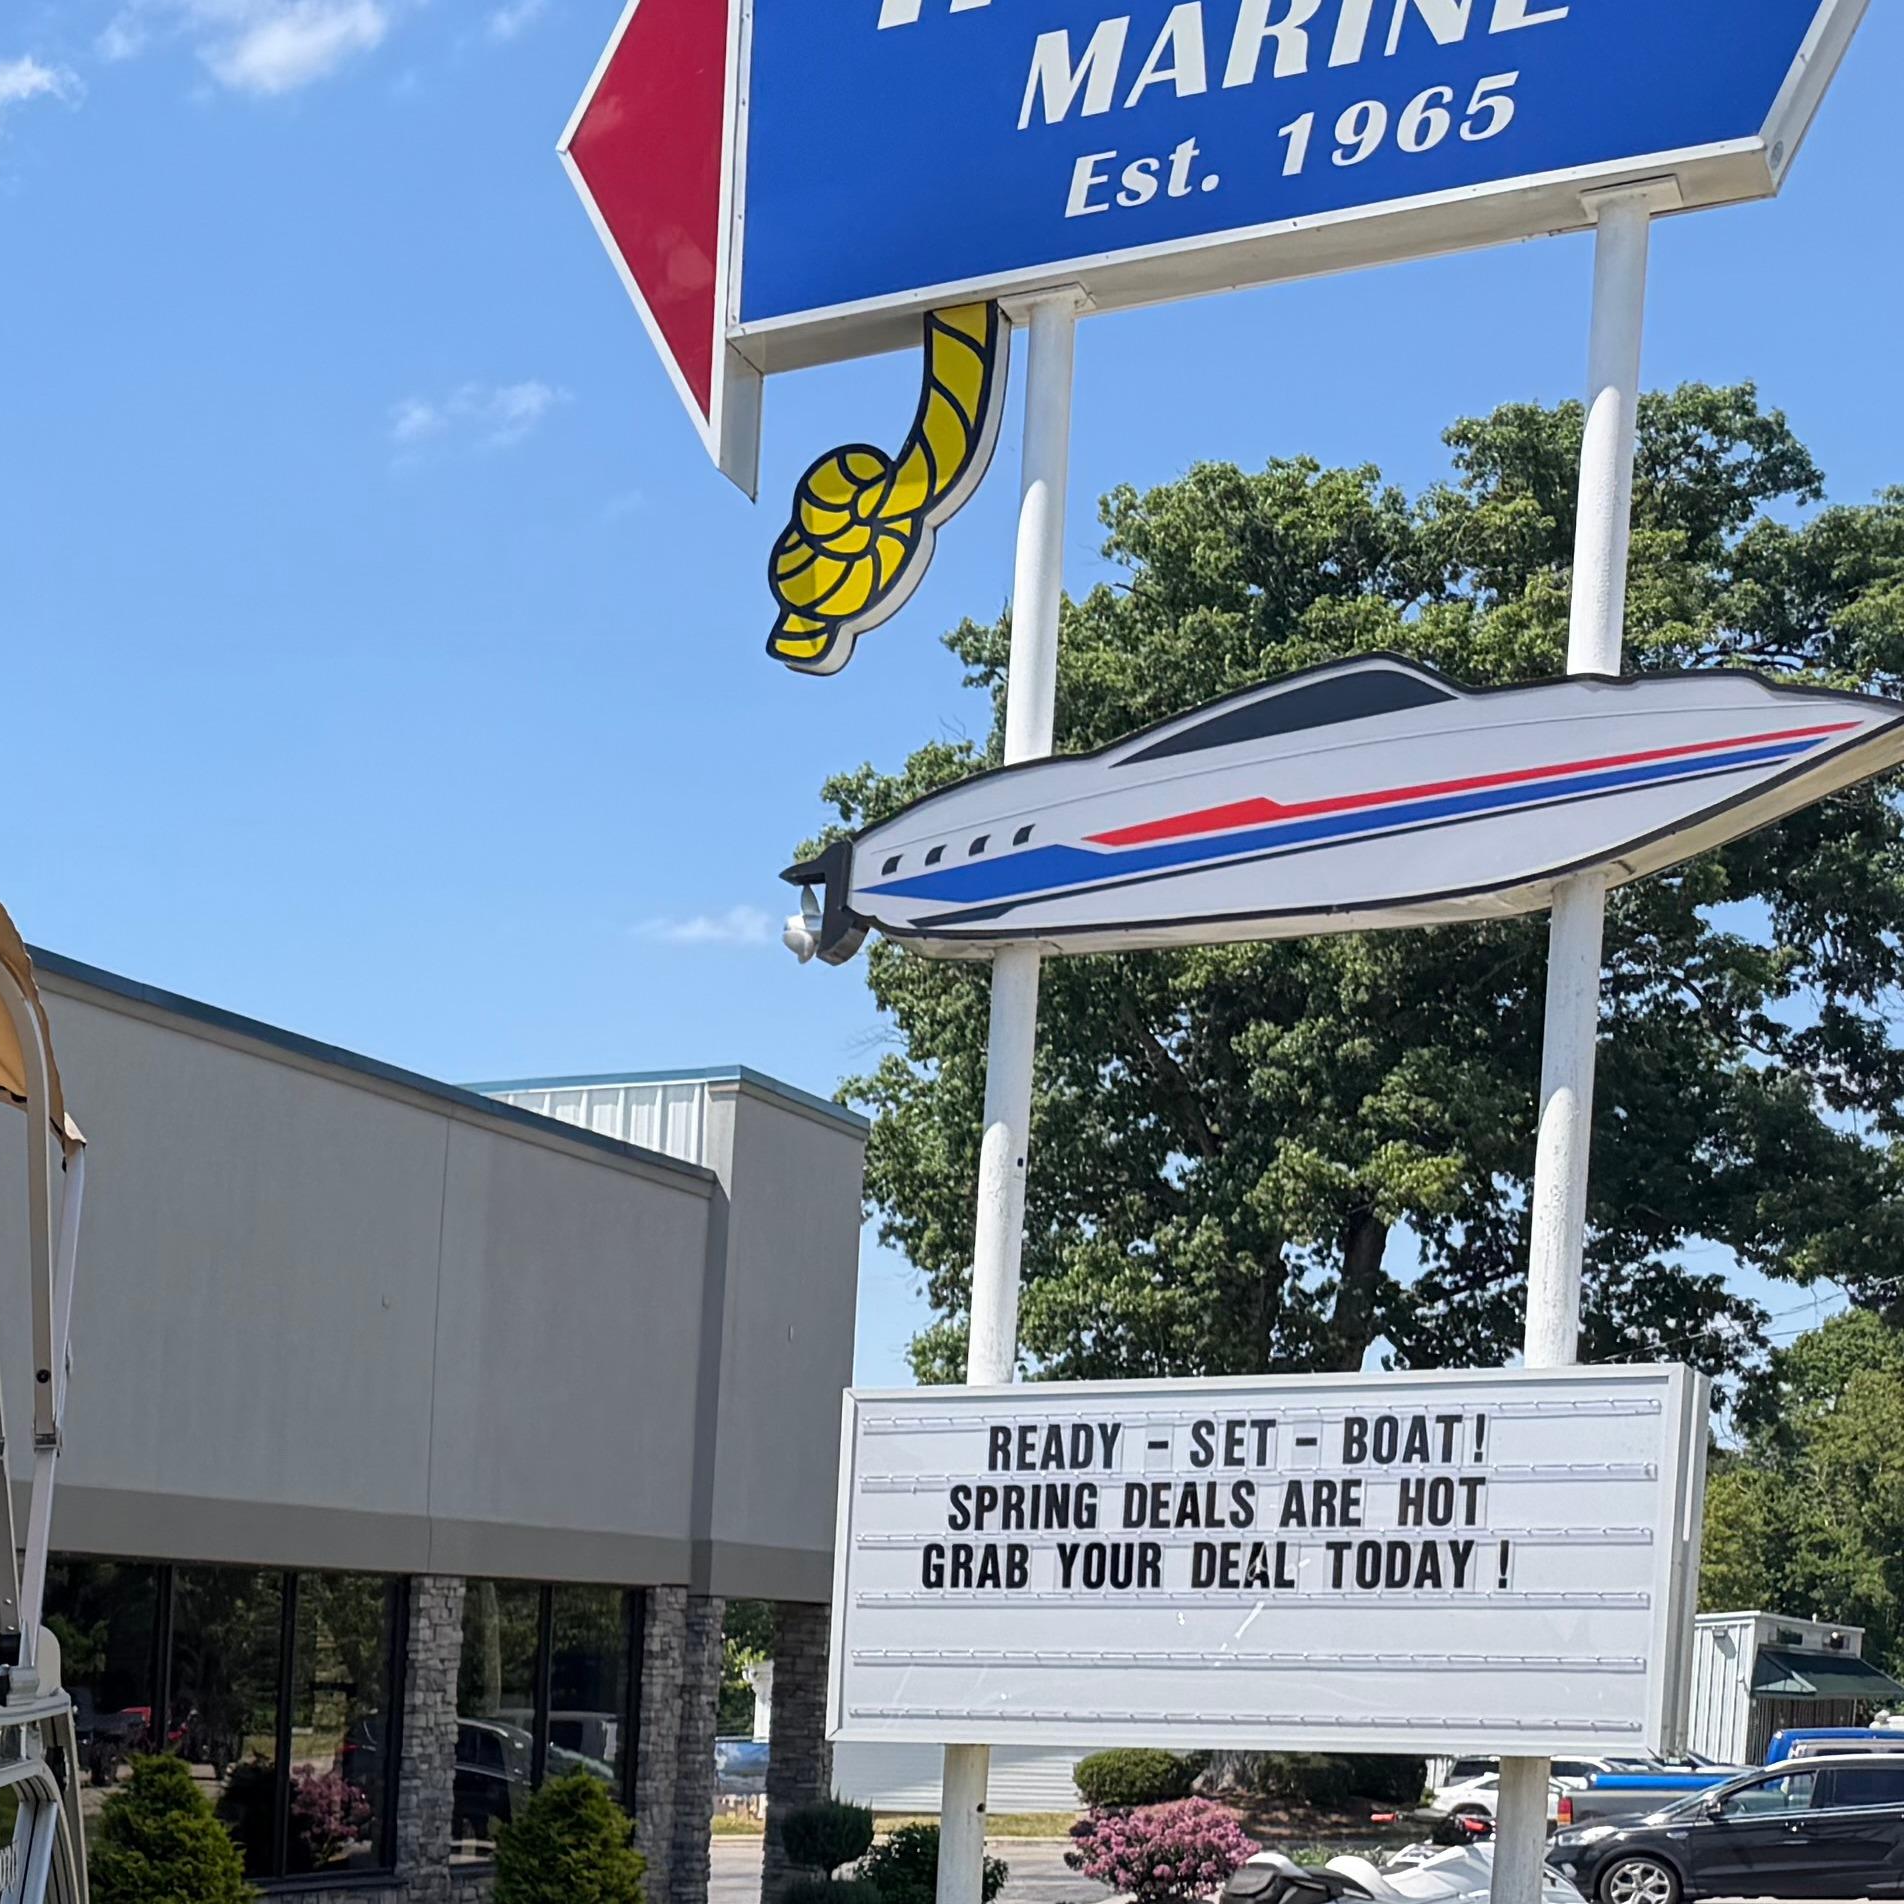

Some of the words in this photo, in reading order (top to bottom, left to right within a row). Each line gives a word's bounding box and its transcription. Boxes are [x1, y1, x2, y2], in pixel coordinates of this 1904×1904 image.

[1066, 138, 1219, 218] Est.
[1278, 72, 1519, 176] 1965
[988, 1423, 1121, 1471] READY
[1190, 1419, 1276, 1468] SET
[1342, 1414, 1485, 1464] BOAT!
[948, 1482, 1098, 1531] SPRING
[1123, 1480, 1255, 1529] DEALS
[1280, 1479, 1362, 1527] ARE
[1398, 1476, 1486, 1526] HOT
[922, 1543, 1029, 1590] GRAB
[1057, 1542, 1162, 1590] YOUR
[1191, 1541, 1295, 1589] DEAL
